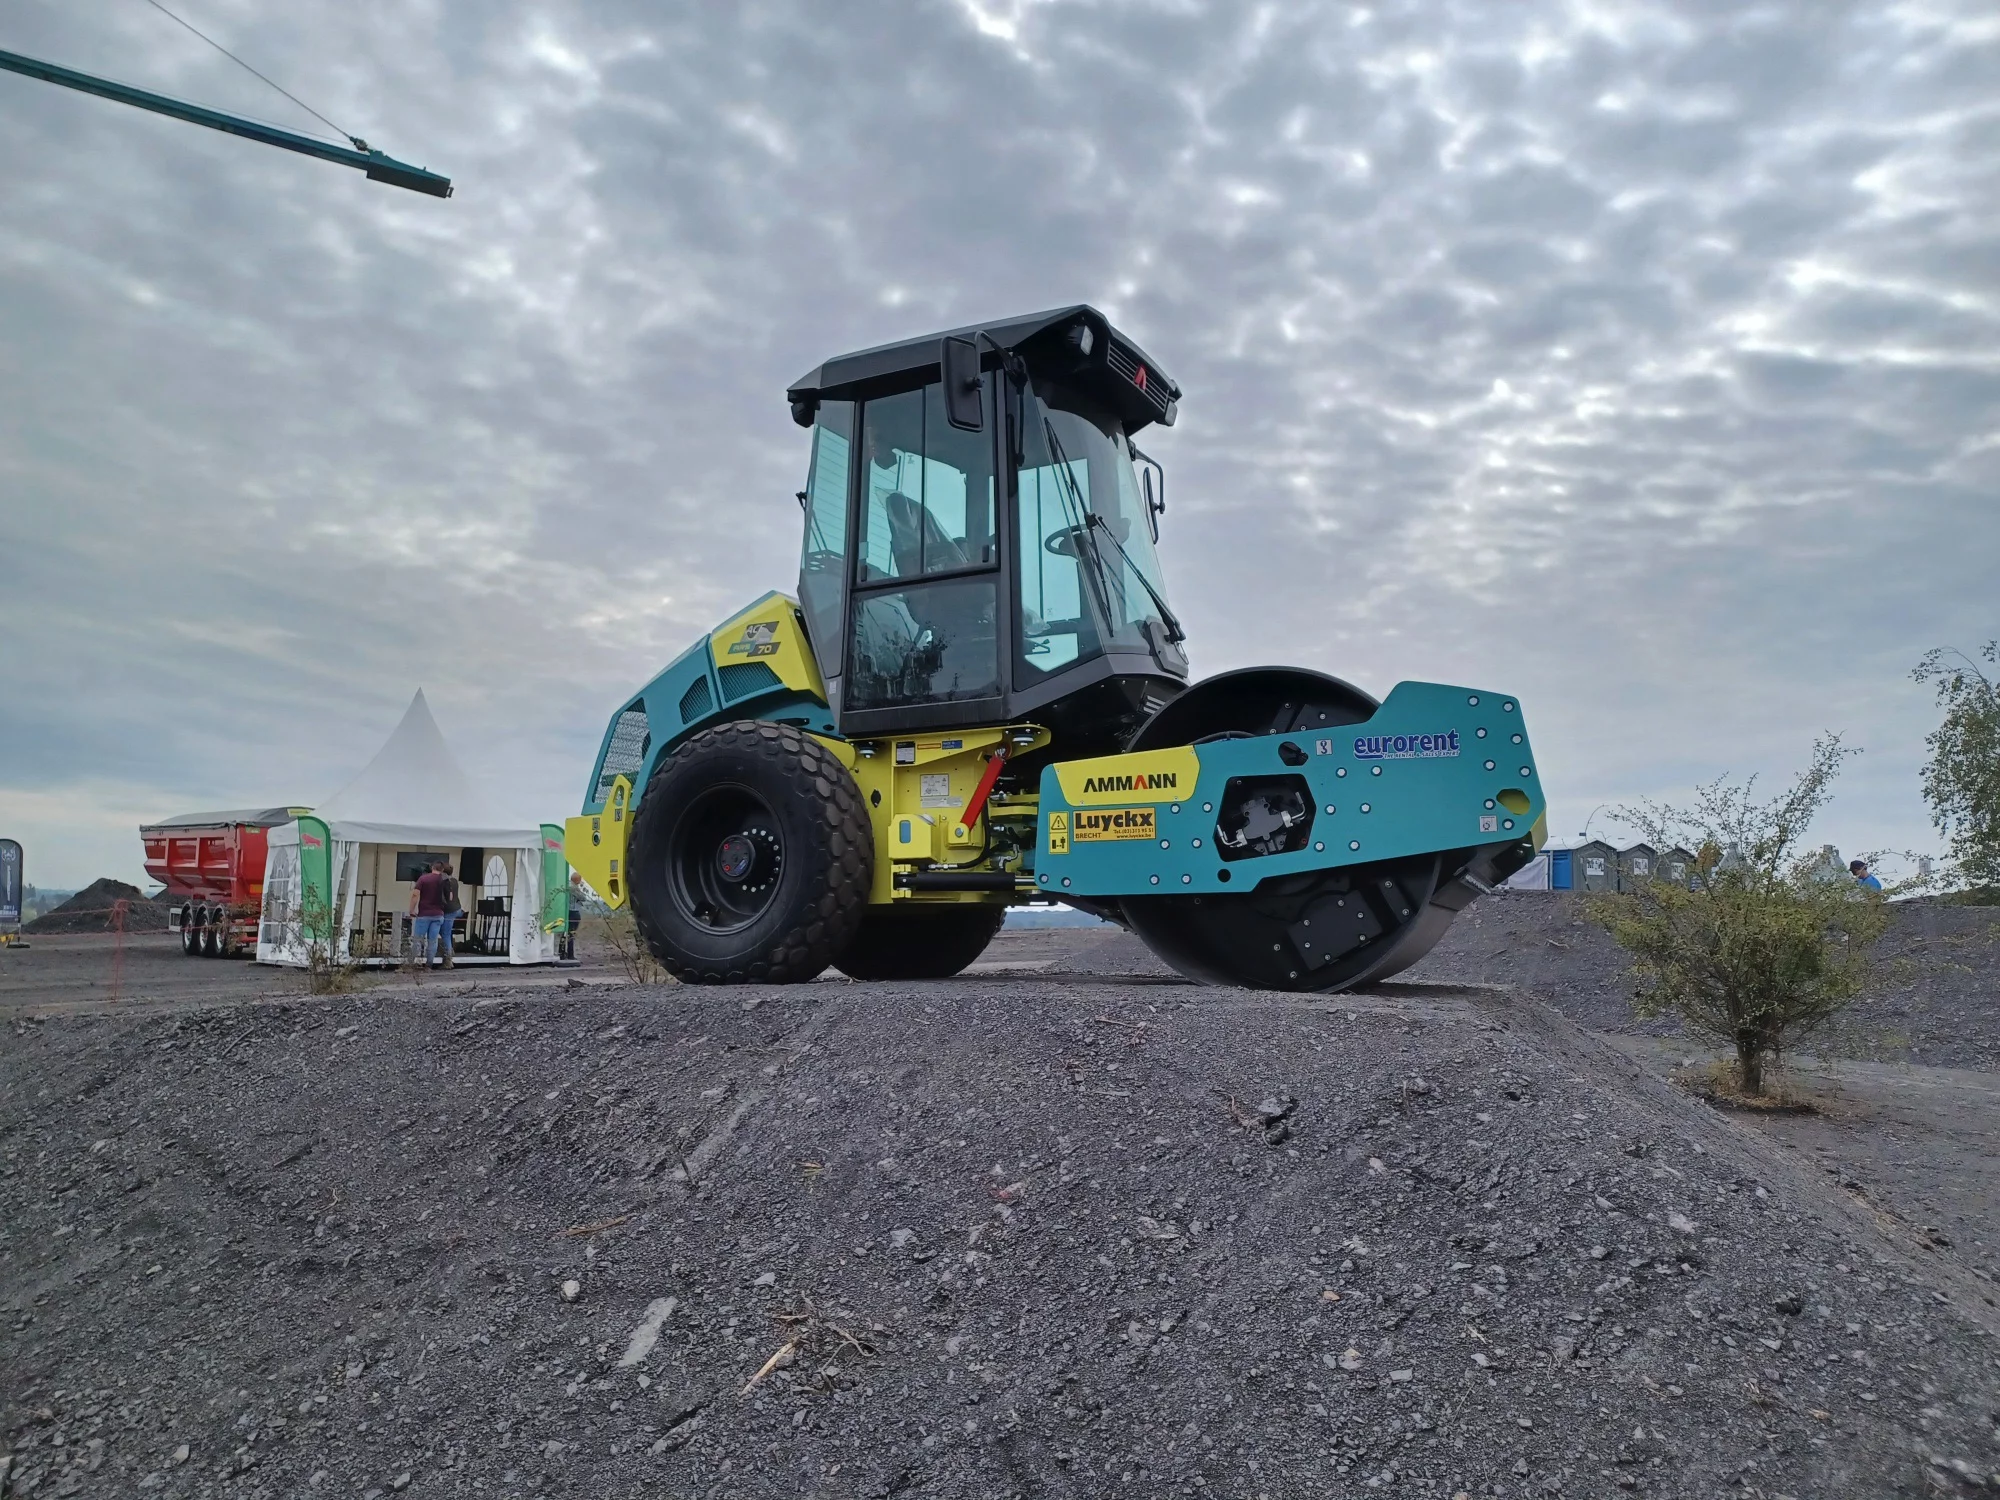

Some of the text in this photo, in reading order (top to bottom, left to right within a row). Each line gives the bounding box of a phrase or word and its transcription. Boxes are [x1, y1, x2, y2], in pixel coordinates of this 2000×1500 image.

[758, 645, 771, 654] 70
[1354, 729, 1459, 754] eurorent
[1083, 773, 1176, 793] AMMANN
[1075, 811, 1153, 832] Luyckx
